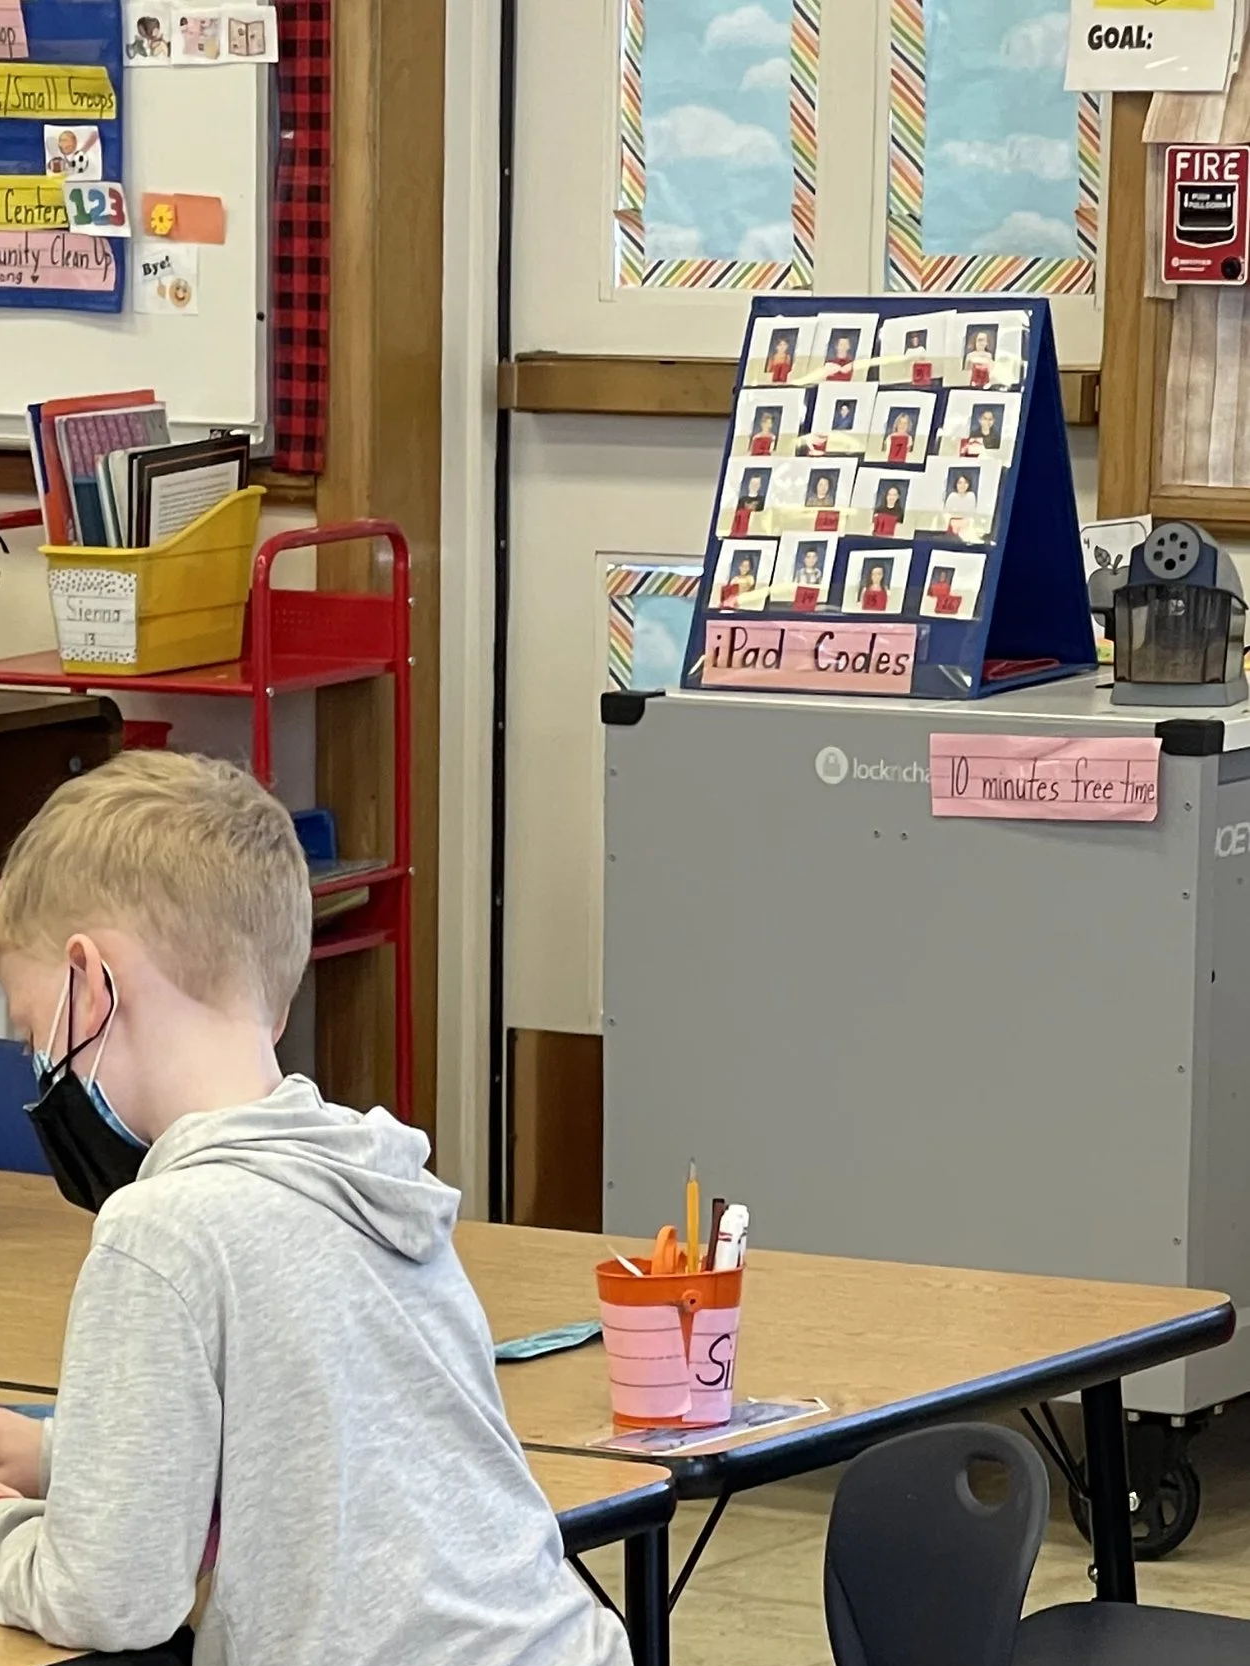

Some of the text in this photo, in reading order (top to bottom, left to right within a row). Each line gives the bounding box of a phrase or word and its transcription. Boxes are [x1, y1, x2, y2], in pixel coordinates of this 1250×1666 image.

[1087, 24, 1153, 50] GOAL:
[68, 76, 113, 118] Groups
[1175, 152, 1240, 181] FIRE
[4, 186, 69, 225] Centers
[51, 234, 89, 266] Clean
[94, 237, 112, 282] Up
[142, 255, 172, 278] Bye!
[67, 595, 121, 622] Sienna
[712, 626, 911, 676] iPad Codes
[951, 756, 1155, 804] 10 minutes free time
[1214, 822, 1250, 860] JOE
